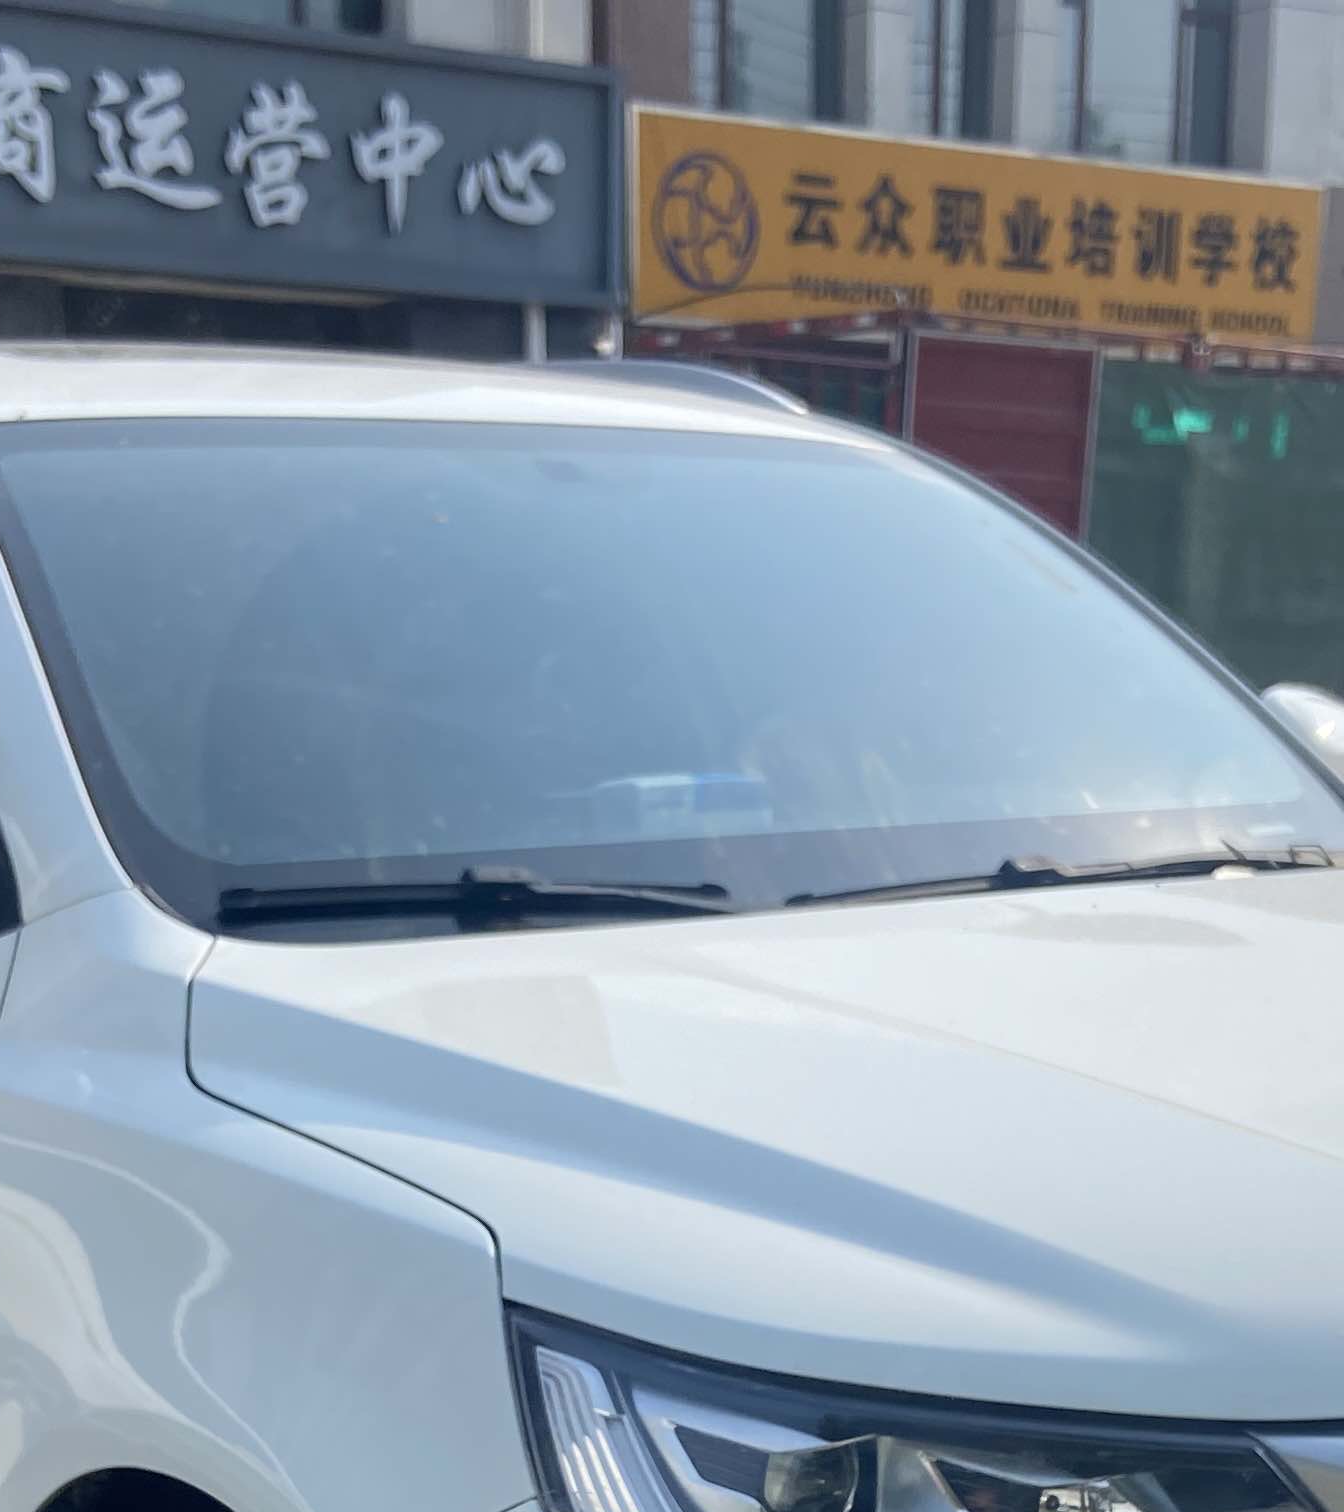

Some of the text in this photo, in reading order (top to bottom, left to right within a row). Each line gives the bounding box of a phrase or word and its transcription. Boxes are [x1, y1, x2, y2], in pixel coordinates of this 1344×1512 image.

[784, 171, 1302, 293] 云众职业培训学校
